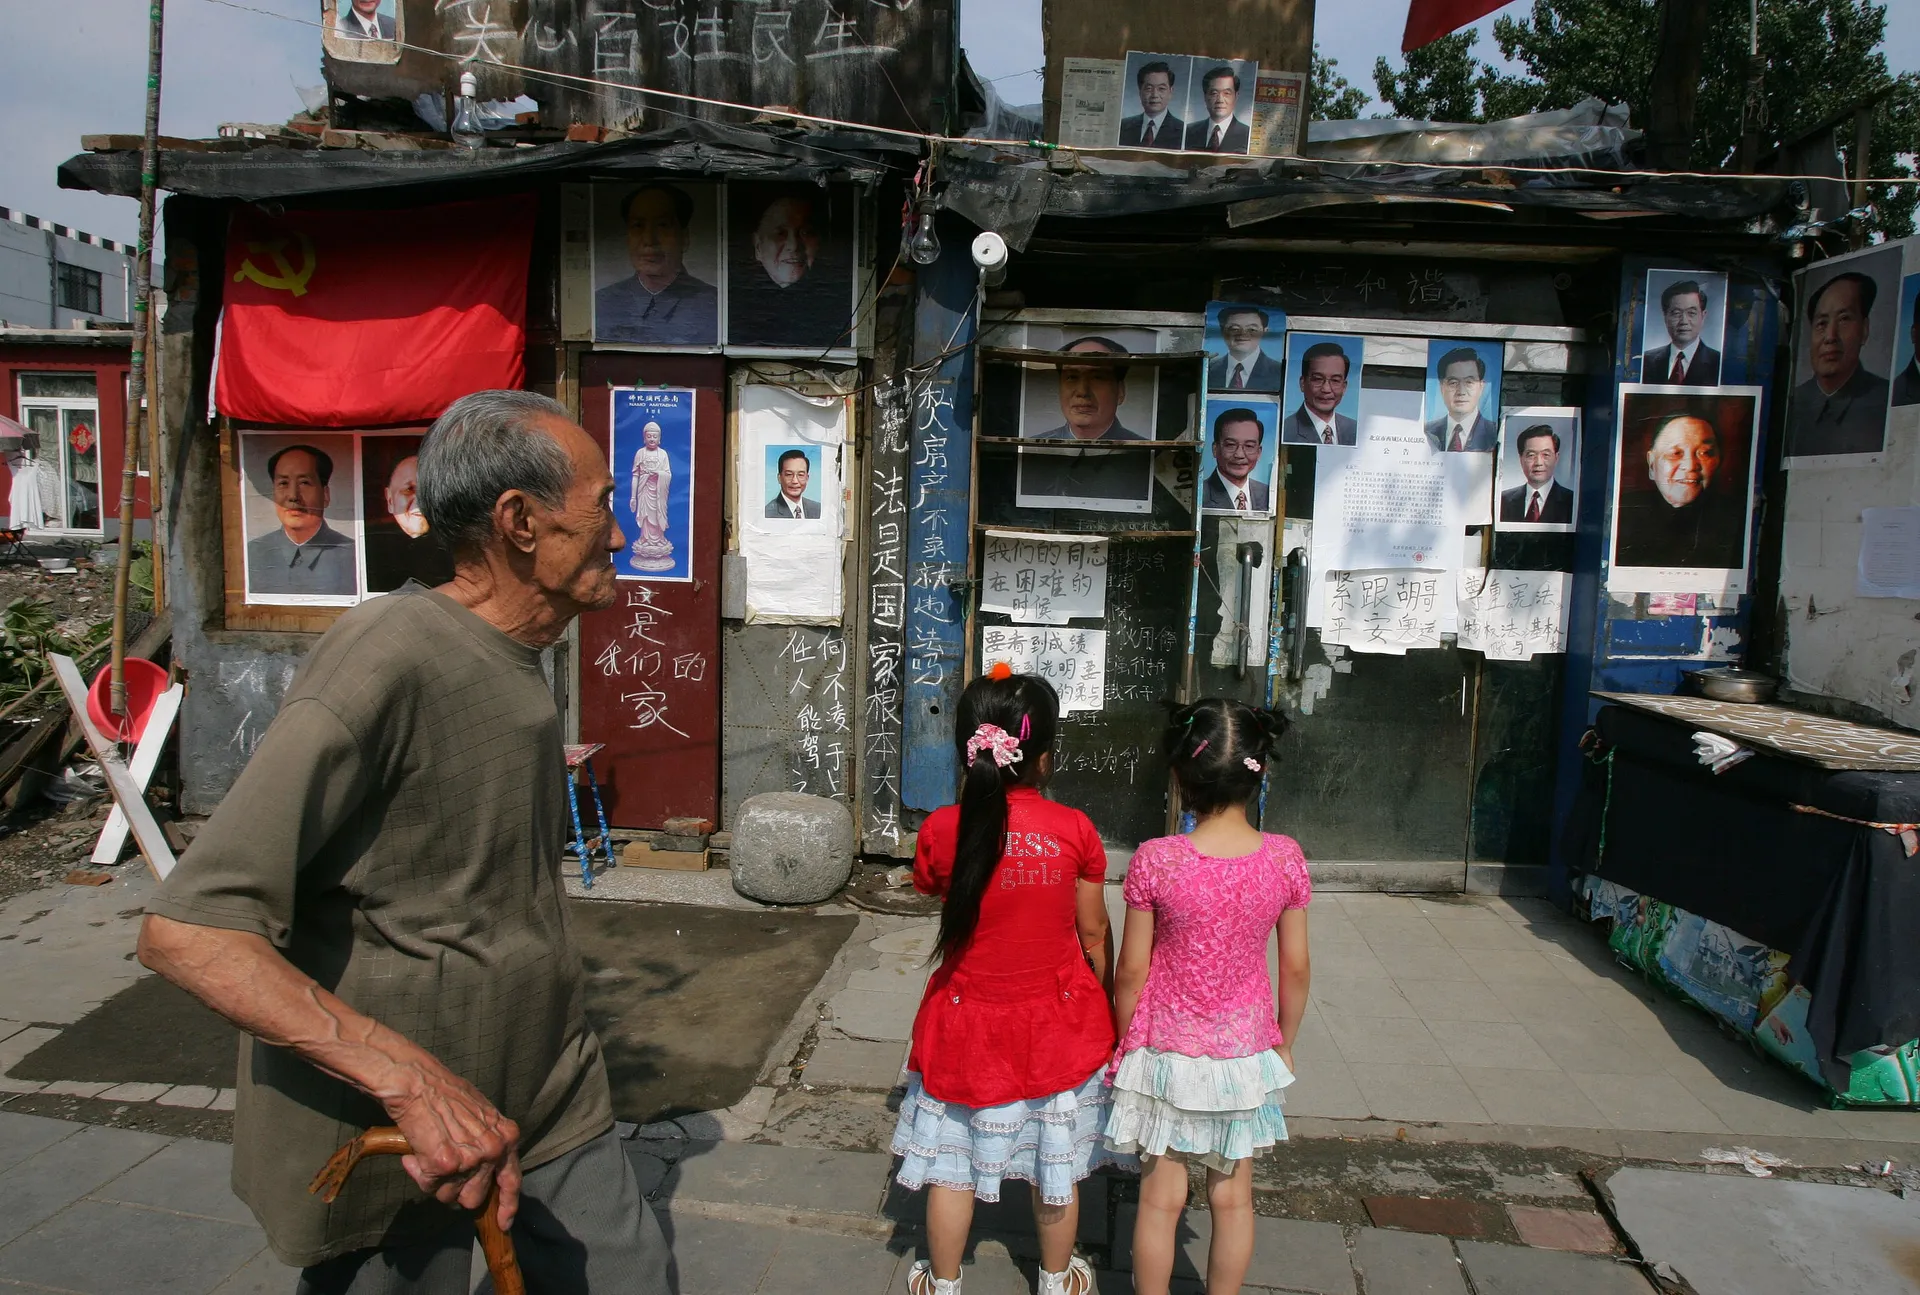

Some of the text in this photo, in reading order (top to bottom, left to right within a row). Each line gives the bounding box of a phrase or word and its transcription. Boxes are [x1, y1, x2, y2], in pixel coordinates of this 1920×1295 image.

[453, 4, 898, 75] 关心百姓民生
[987, 538, 1107, 570] 我们的同志
[988, 568, 1092, 597] 在困难的
[1331, 571, 1438, 612] 紧跟胡哥
[625, 612, 666, 645] 是
[984, 629, 1089, 655] 要看到成绩
[1329, 613, 1440, 645] 平安奥运
[594, 639, 706, 682] 我们的
[621, 681, 690, 738] 家
[1001, 860, 1062, 890] girls
